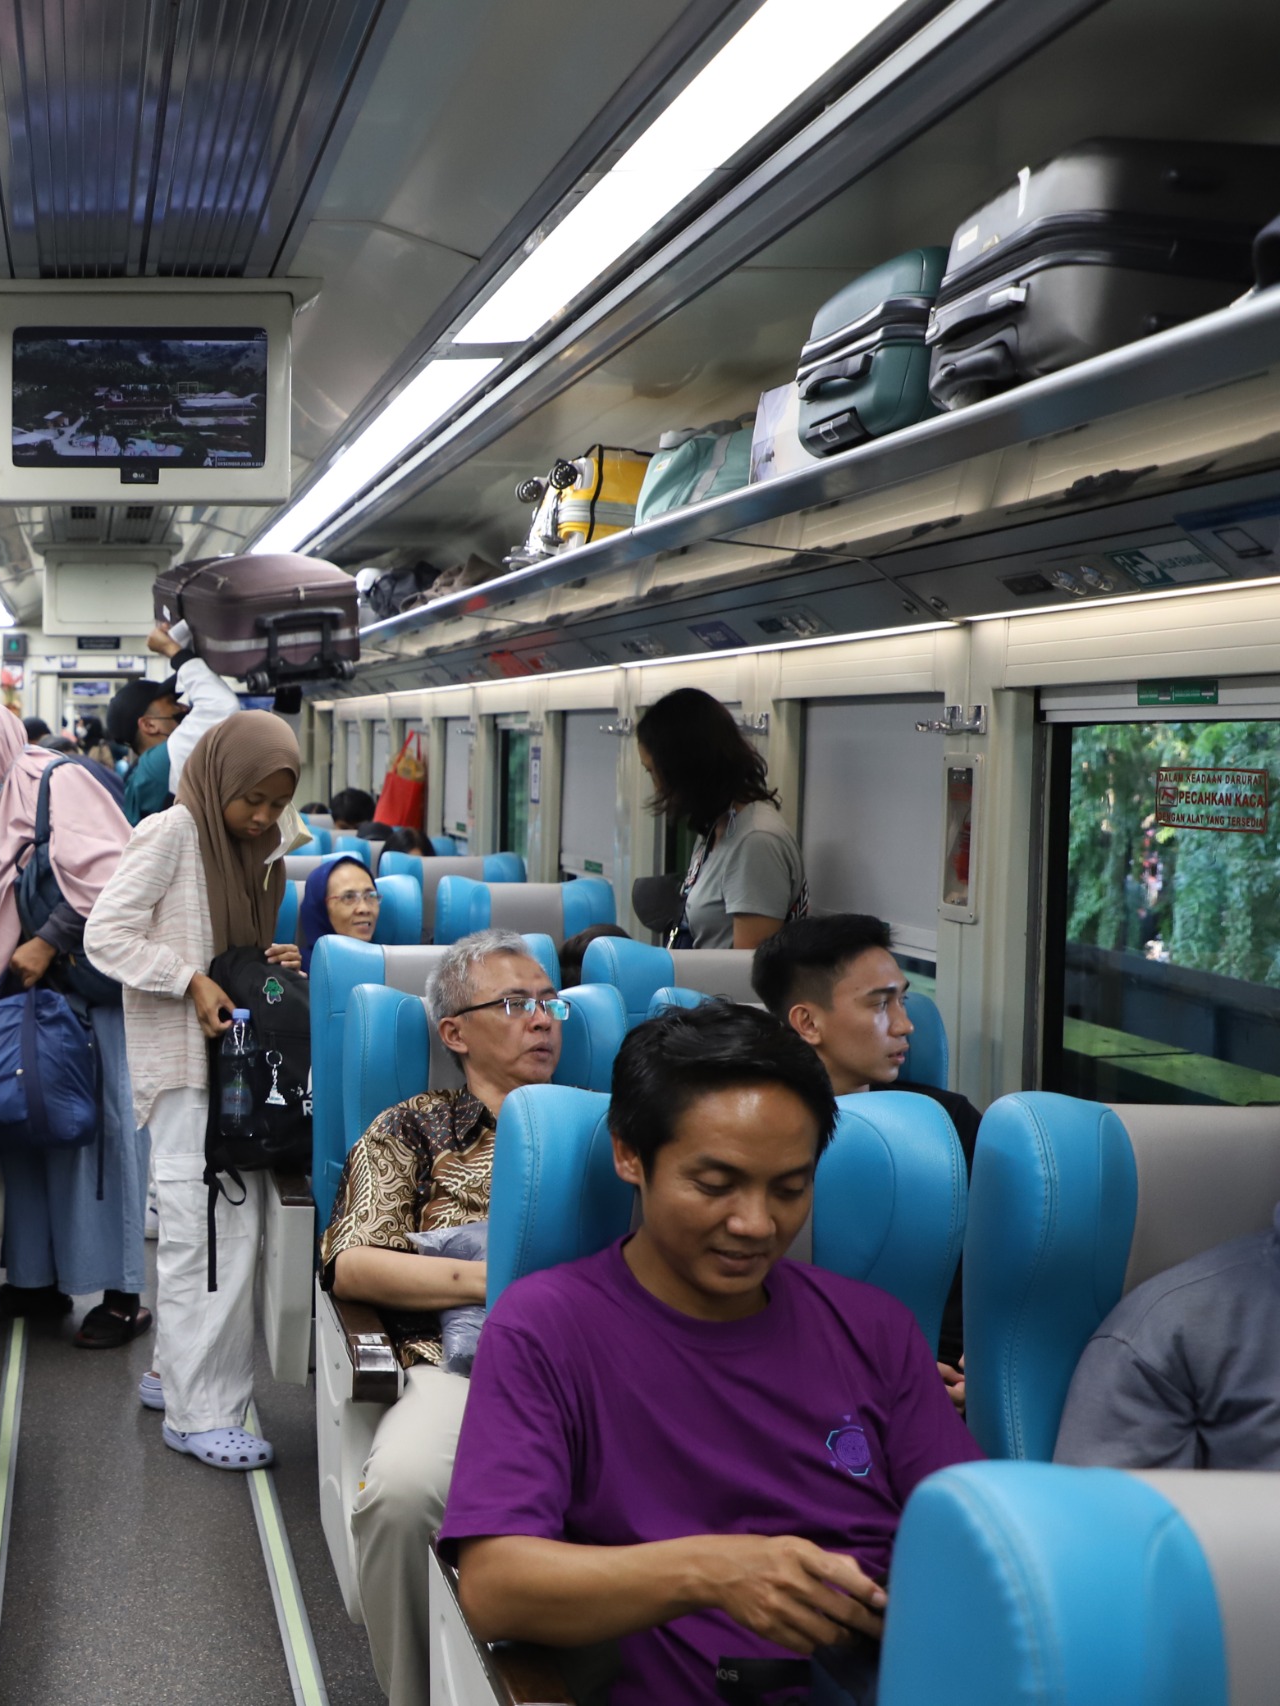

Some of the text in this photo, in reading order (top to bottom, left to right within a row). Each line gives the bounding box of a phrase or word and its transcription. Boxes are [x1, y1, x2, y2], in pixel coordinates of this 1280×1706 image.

[1158, 772, 1263, 786] DALAM KEADAAN DARURAT
[1178, 790, 1265, 808] PECAHKAN KACA
[1158, 812, 1264, 828] DENGAN ALAT YANG TERSEDIA
